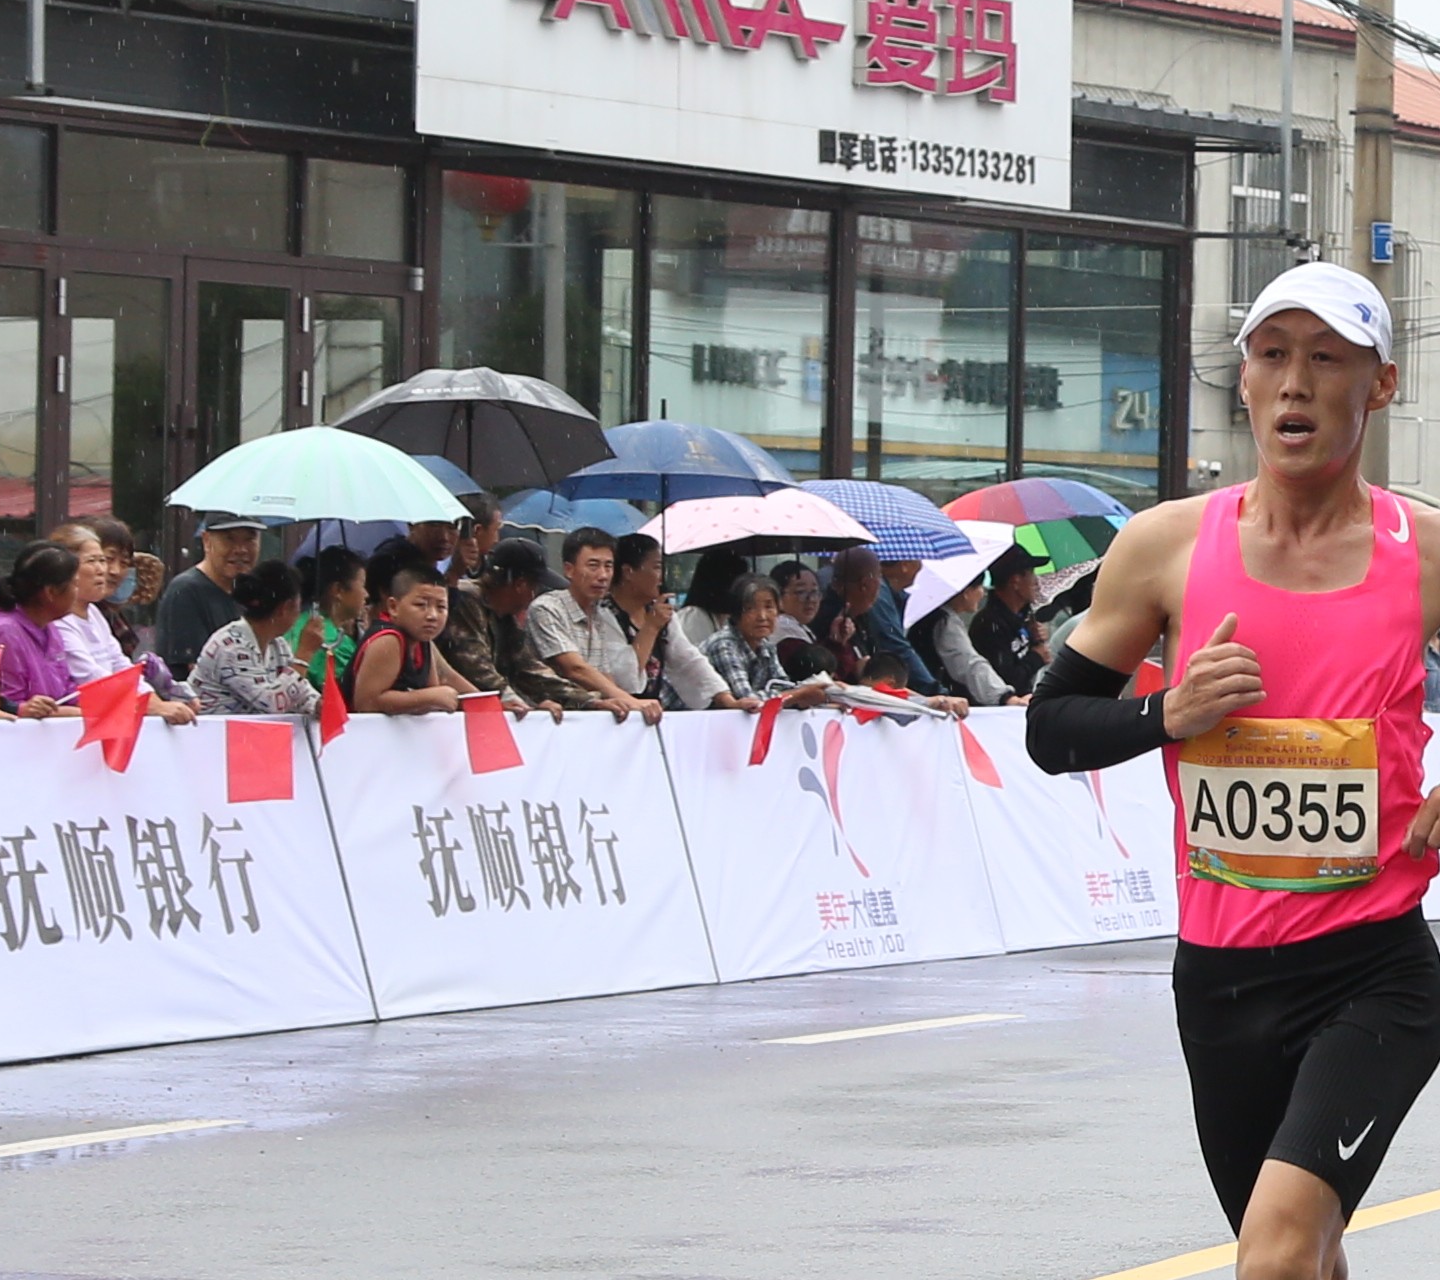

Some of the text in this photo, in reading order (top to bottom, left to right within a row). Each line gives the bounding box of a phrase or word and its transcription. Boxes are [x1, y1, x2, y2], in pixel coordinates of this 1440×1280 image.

[1190, 778, 1367, 843] A0355
[411, 797, 629, 918] 抚顺银行
[1084, 868, 1156, 908] 美年大健康
[816, 887, 899, 932] 美年大健康
[1095, 910, 1136, 932] Health
[826, 933, 876, 959] Health
